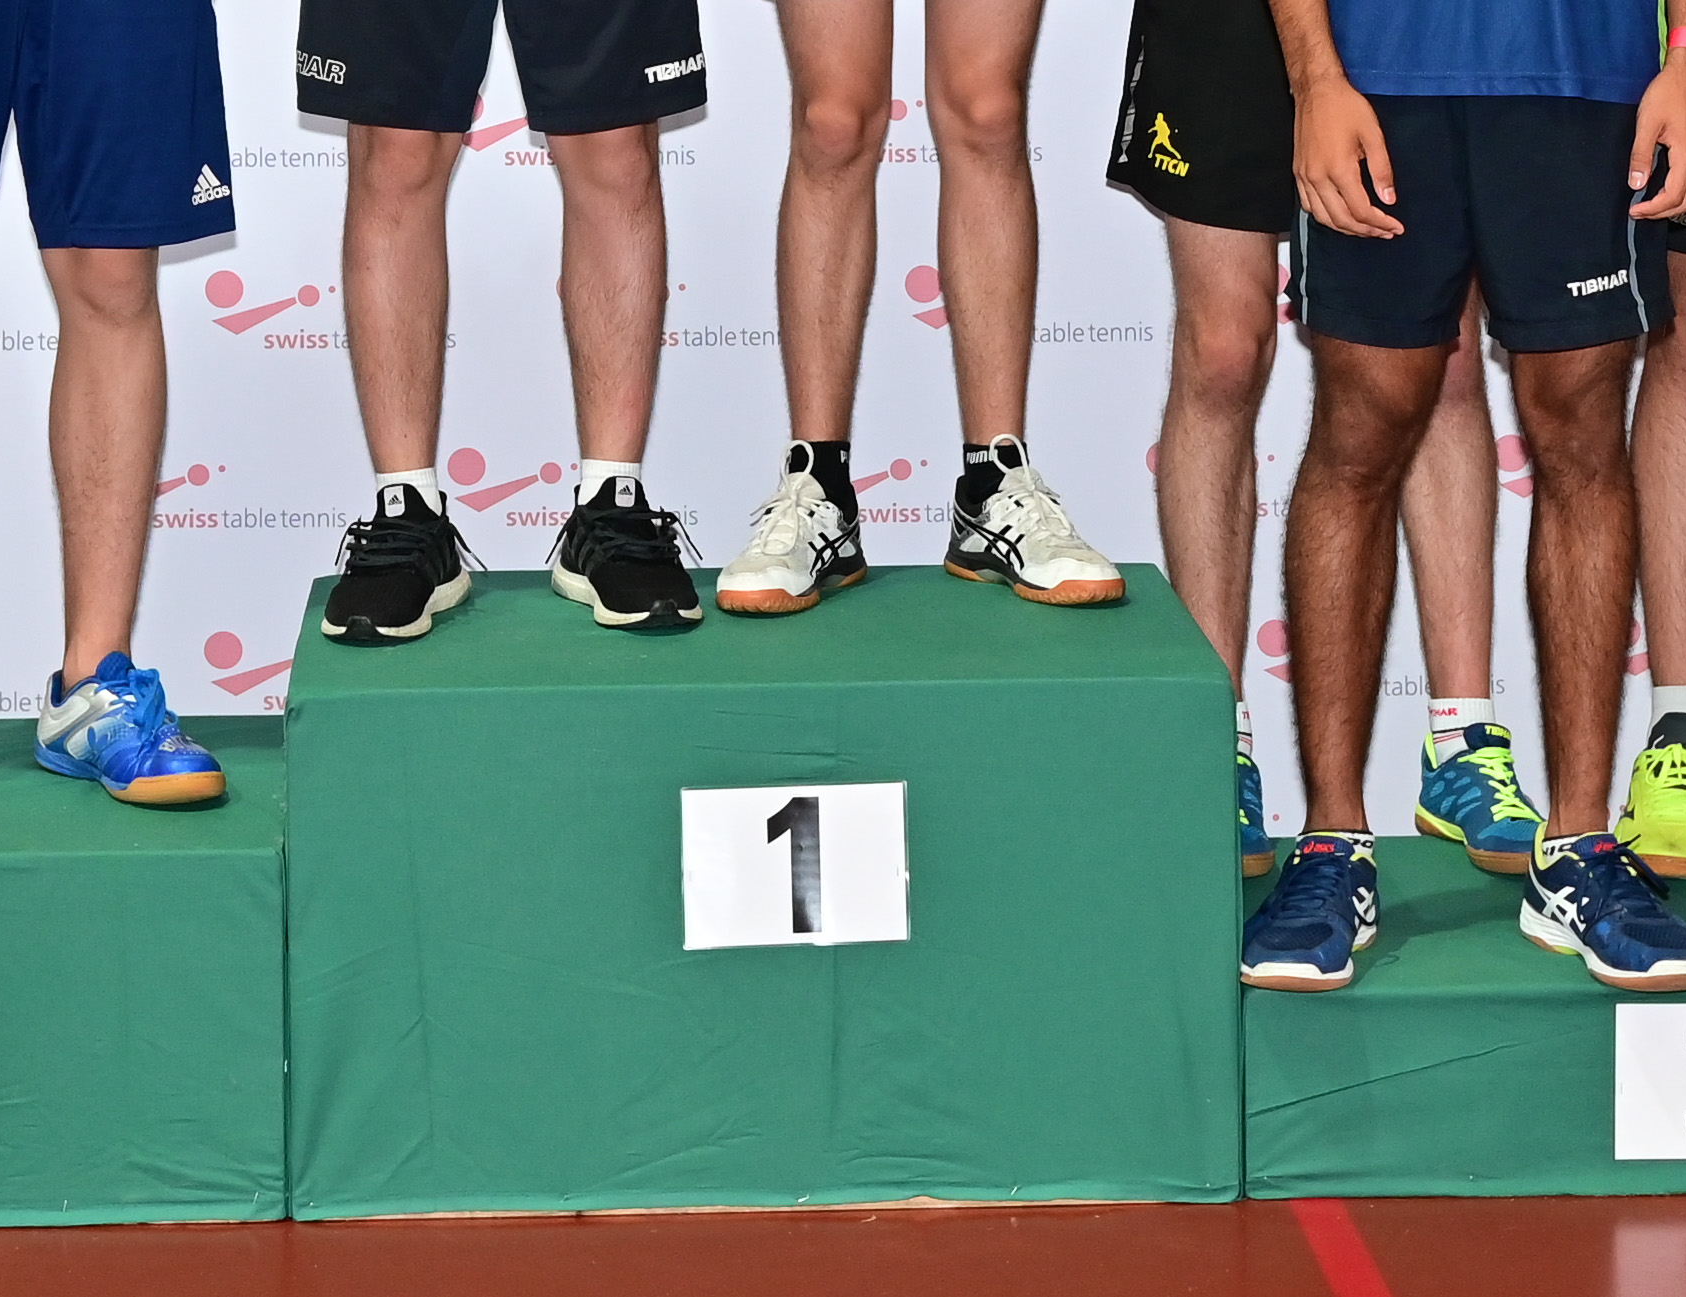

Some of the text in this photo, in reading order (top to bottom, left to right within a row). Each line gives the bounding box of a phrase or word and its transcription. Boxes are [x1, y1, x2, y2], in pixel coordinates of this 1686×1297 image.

[1154, 152, 1190, 177] TTCN
[191, 182, 231, 206] adidas
[1567, 269, 1628, 298] TIBHAR
[767, 796, 822, 933] 1
